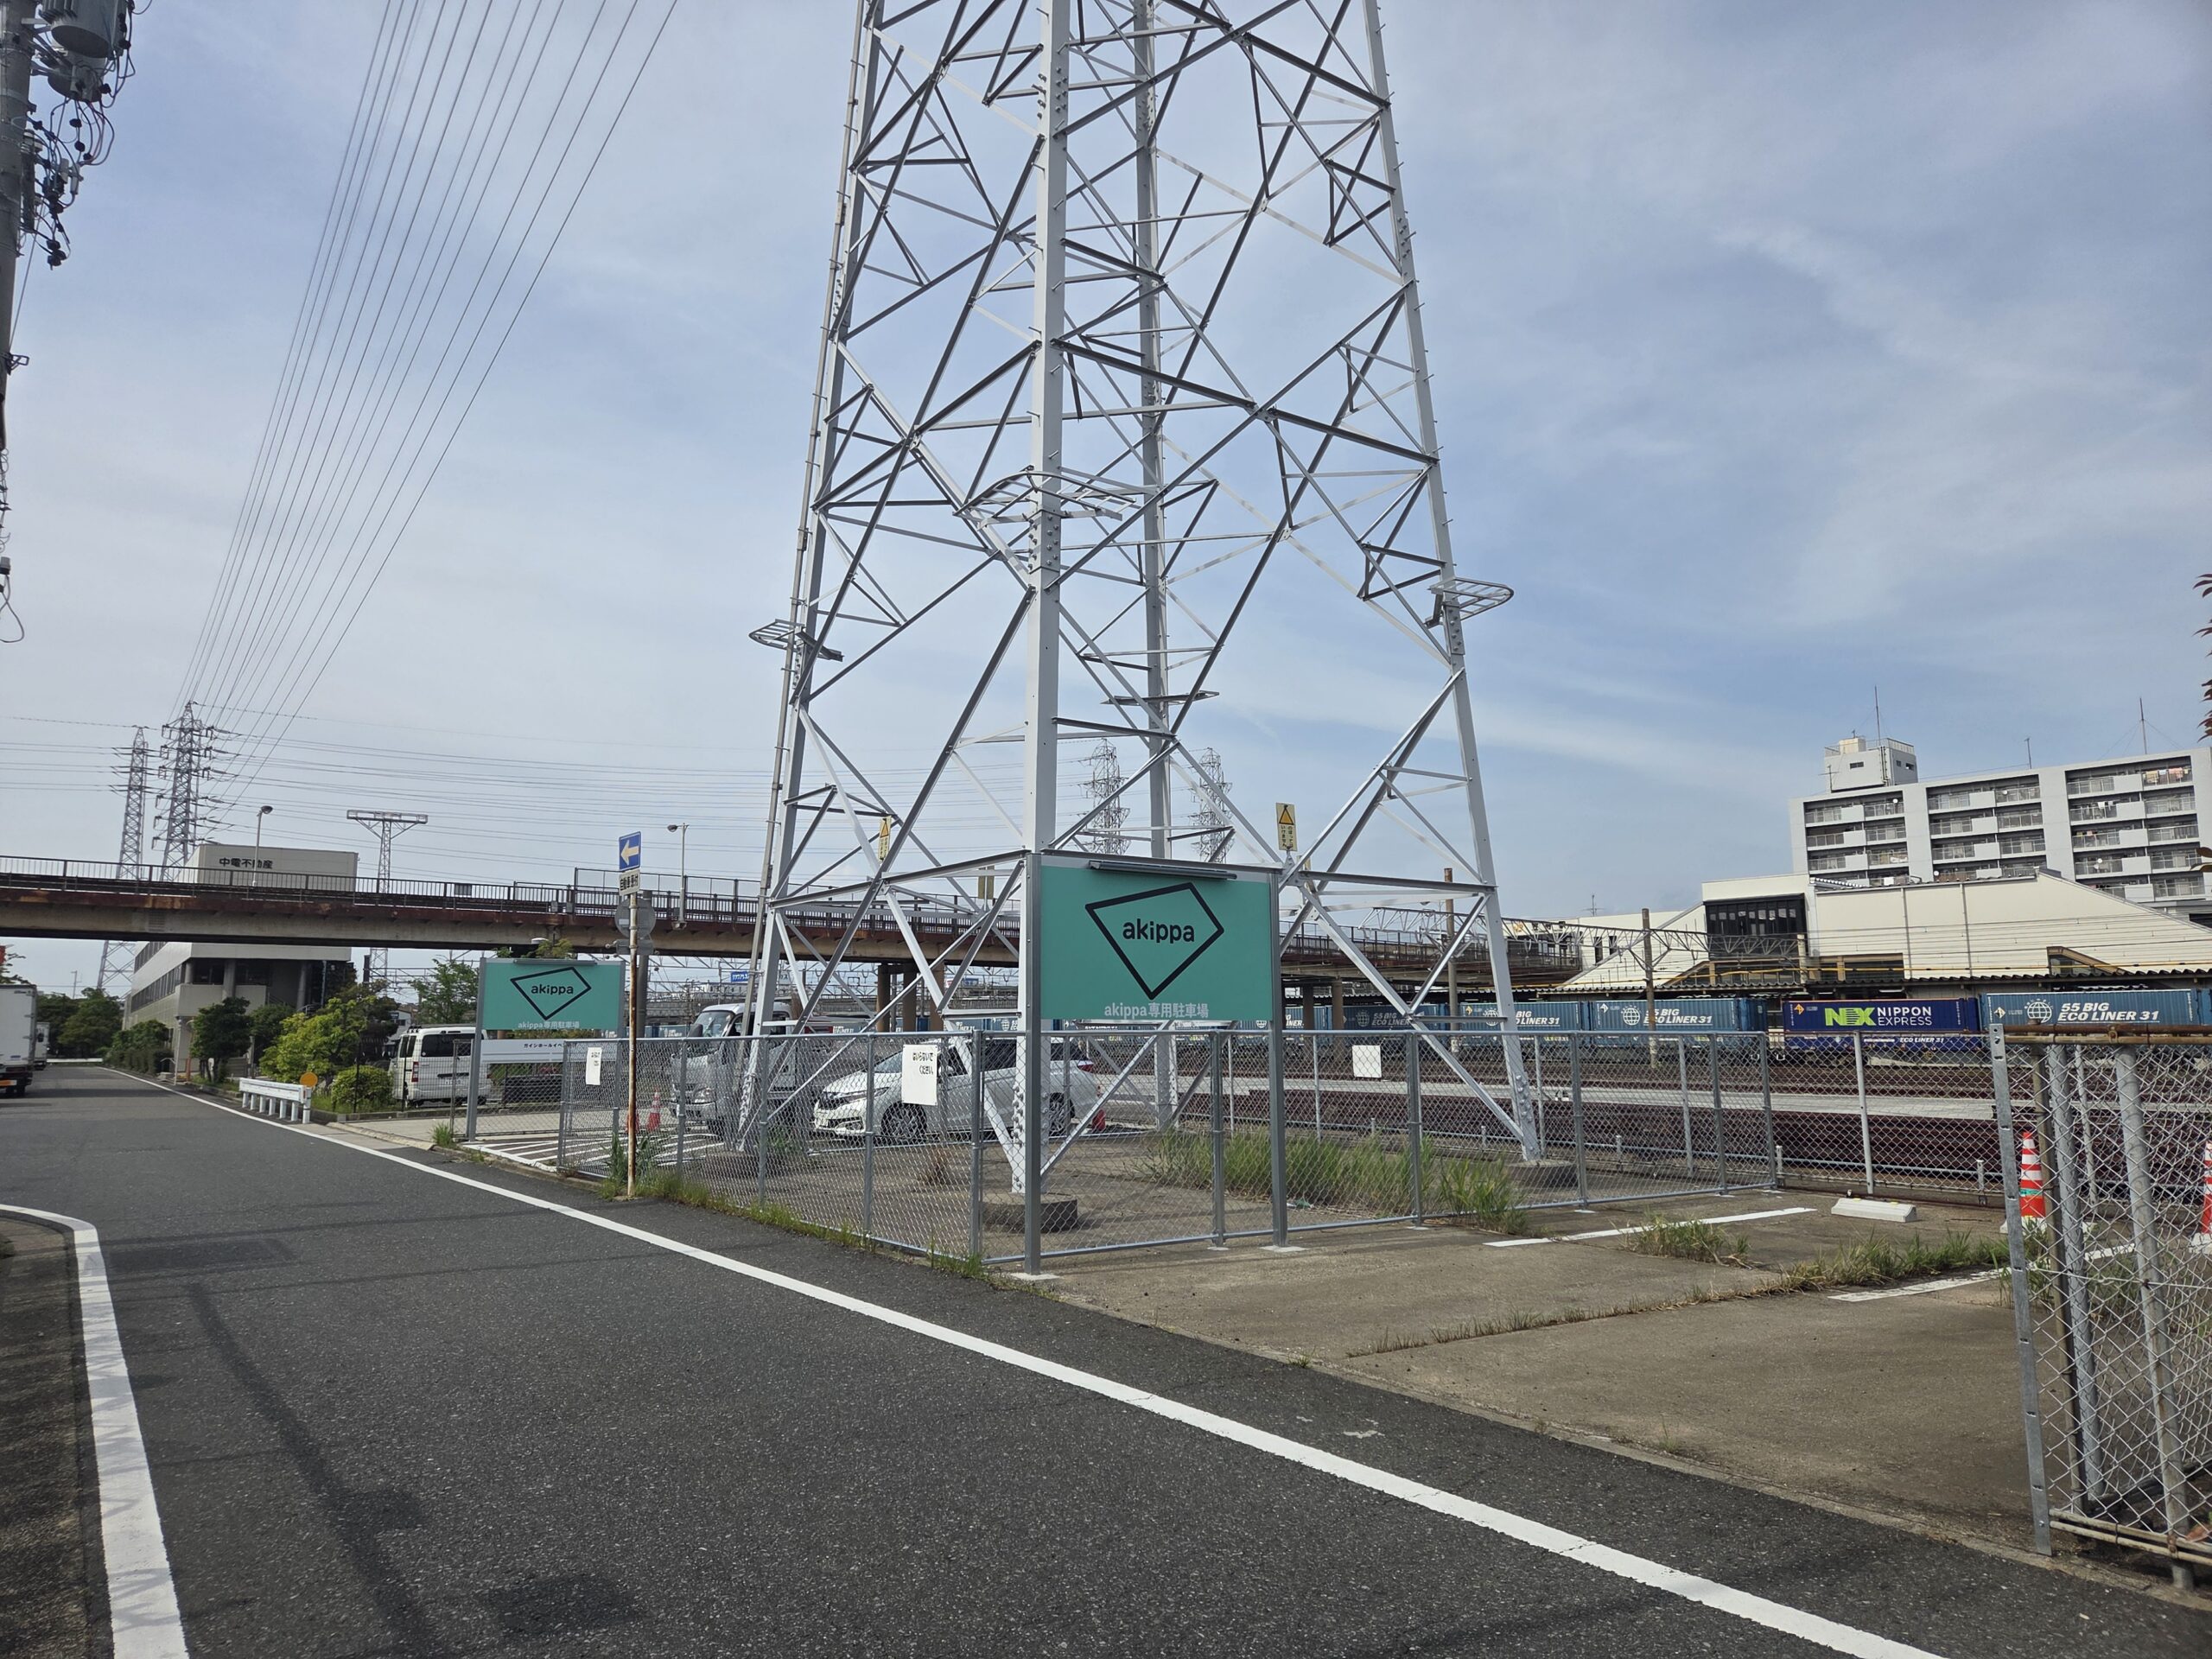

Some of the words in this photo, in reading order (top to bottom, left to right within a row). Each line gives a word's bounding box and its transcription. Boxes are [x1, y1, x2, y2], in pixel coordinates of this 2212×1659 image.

[219, 857, 273, 869] 中電不動産
[1122, 918, 1195, 944] akippa
[531, 984, 574, 995] akippa
[1877, 1007, 1932, 1016] NIPPON
[2061, 1003, 2081, 1012] 55
[2082, 1002, 2109, 1012] BIG
[2057, 1012, 2088, 1021] ECO
[2091, 1011, 2137, 1020] LINER
[2139, 1011, 2159, 1020] 31
[1878, 1017, 1933, 1026] EXPRESS
